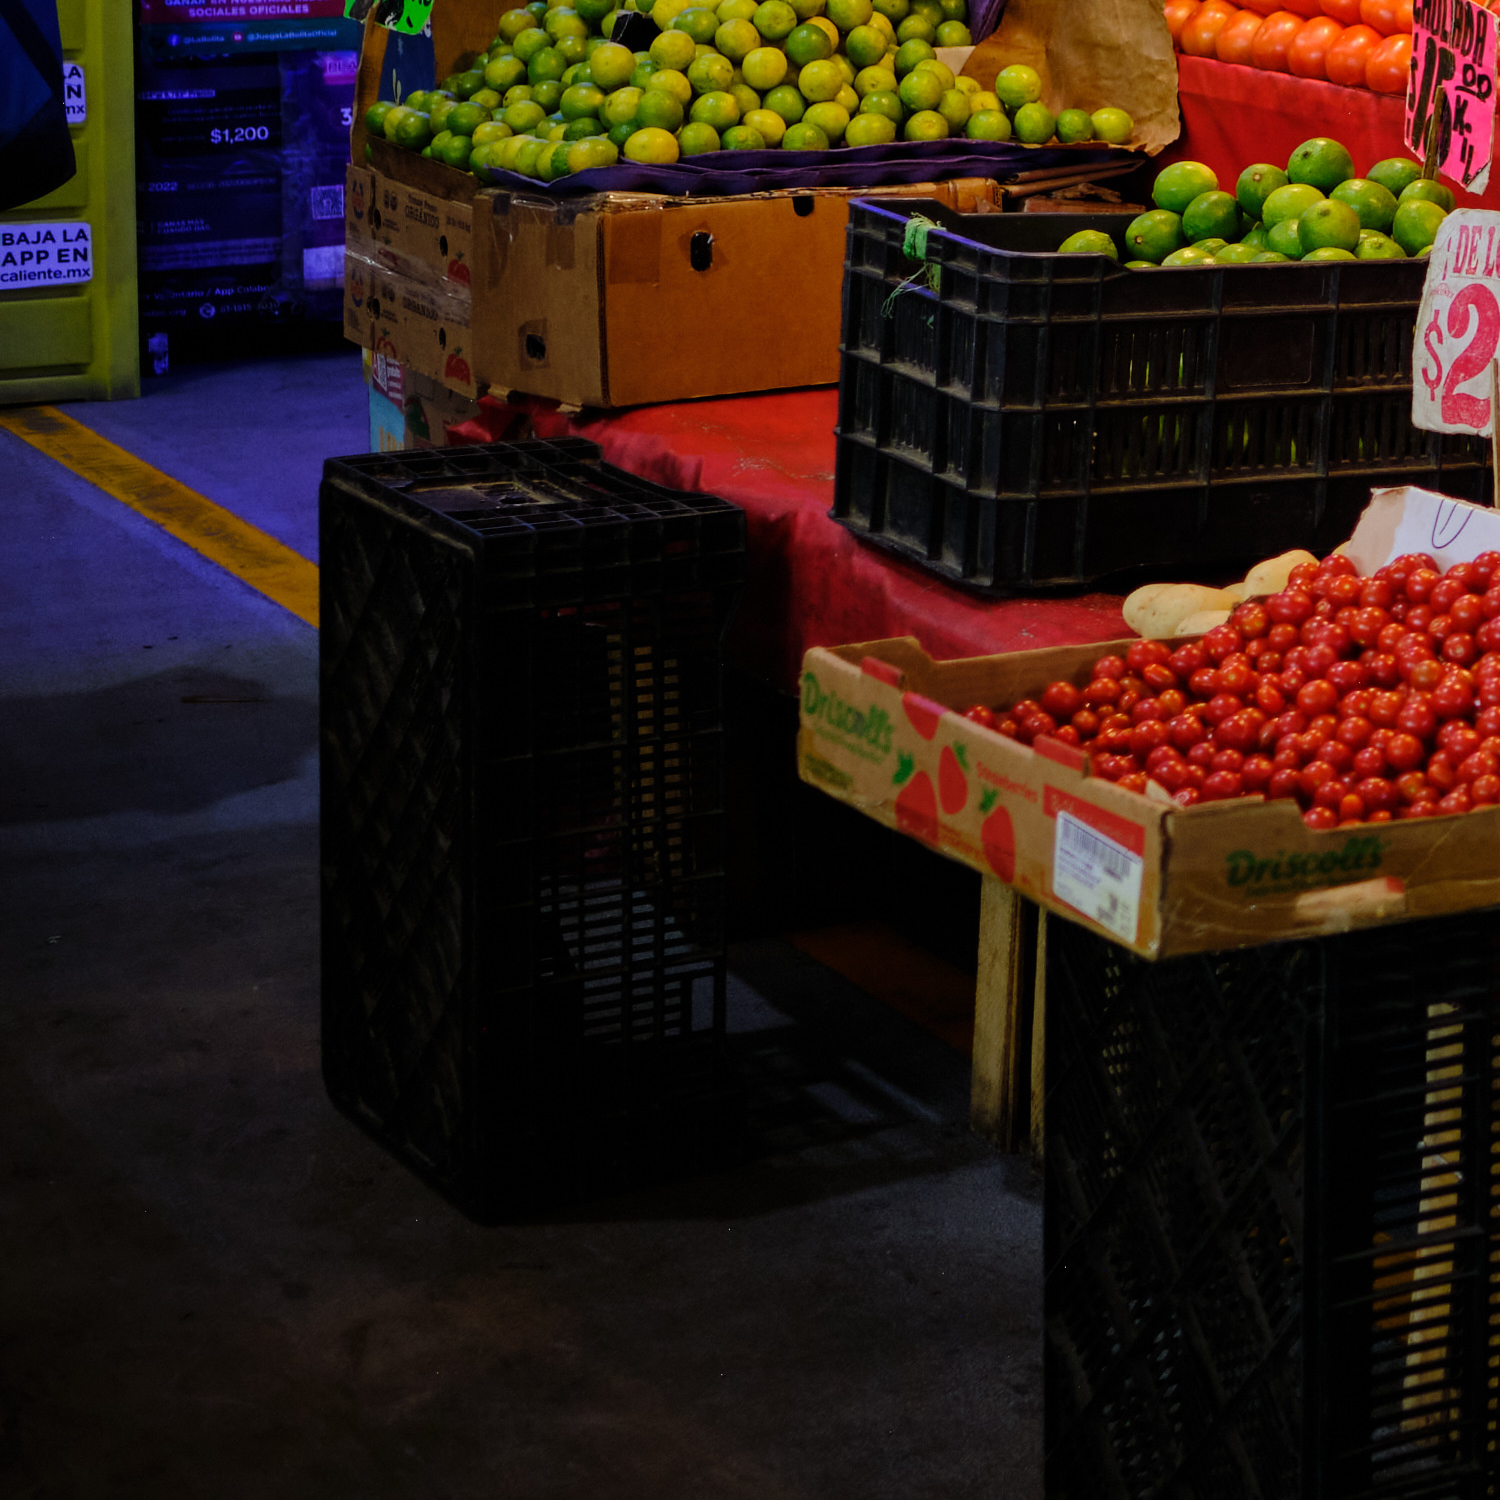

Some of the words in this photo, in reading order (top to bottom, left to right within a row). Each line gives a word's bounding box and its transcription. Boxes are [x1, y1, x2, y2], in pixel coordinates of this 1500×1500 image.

[188, 6, 246, 18] SOCIALES
[249, 4, 310, 16] OFICIALES
[210, 125, 270, 145] $1,200
[148, 181, 179, 193] 2022
[2, 229, 57, 247] BAJA
[62, 227, 90, 244] LA
[2, 249, 52, 267] APP
[57, 247, 90, 264] EN
[0, 266, 92, 284] caliente.mx
[1225, 835, 1385, 888] Driscoll's
